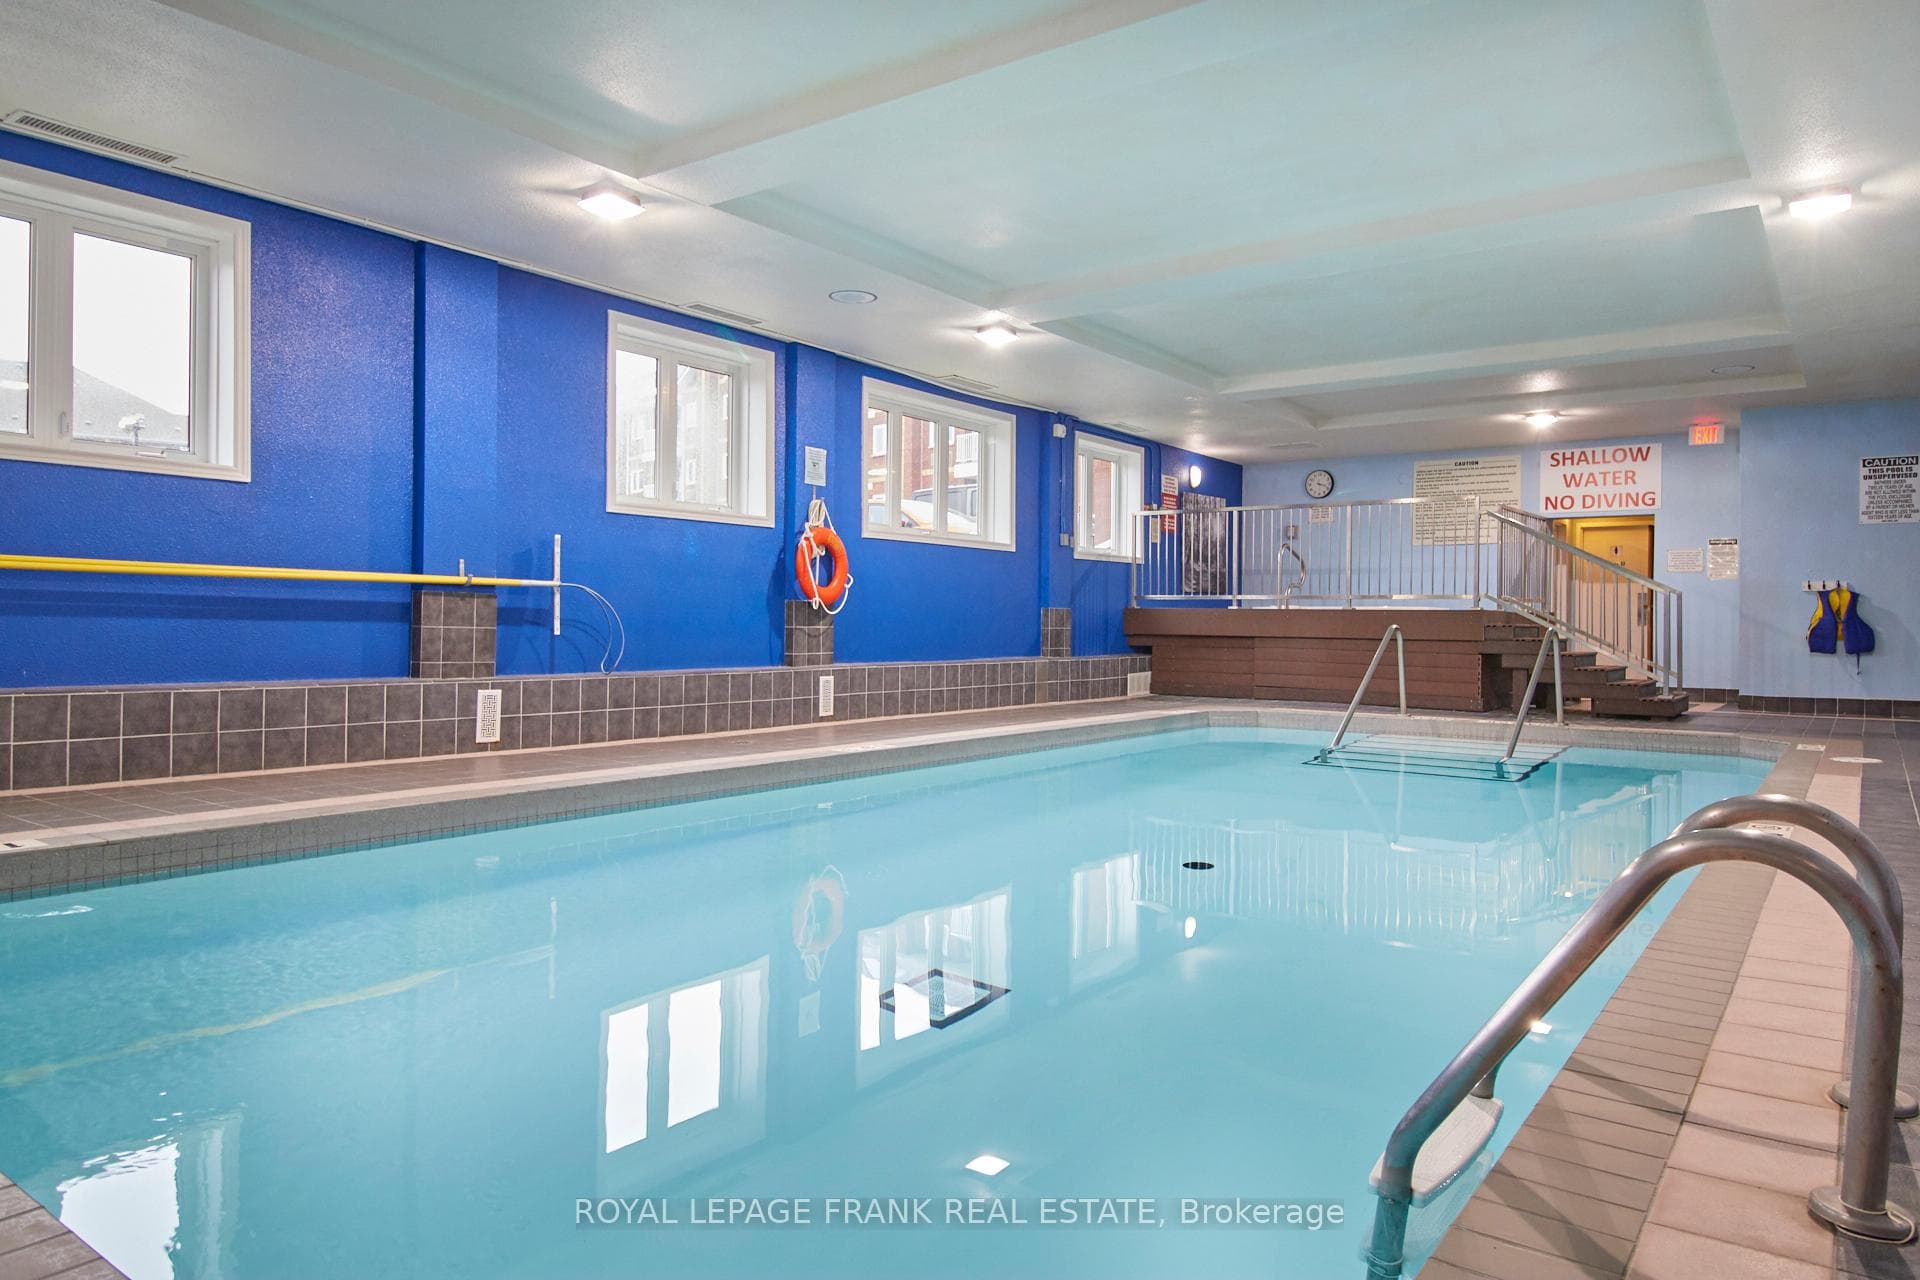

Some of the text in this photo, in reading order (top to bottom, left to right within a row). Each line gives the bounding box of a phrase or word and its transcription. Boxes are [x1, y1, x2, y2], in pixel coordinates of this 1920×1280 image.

[1694, 426, 1718, 444] EXIT
[1550, 446, 1651, 467] SHALLOW
[1864, 457, 1917, 467] CAUTION
[1563, 470, 1637, 488] WATER
[1544, 491, 1656, 511] NO DIVING
